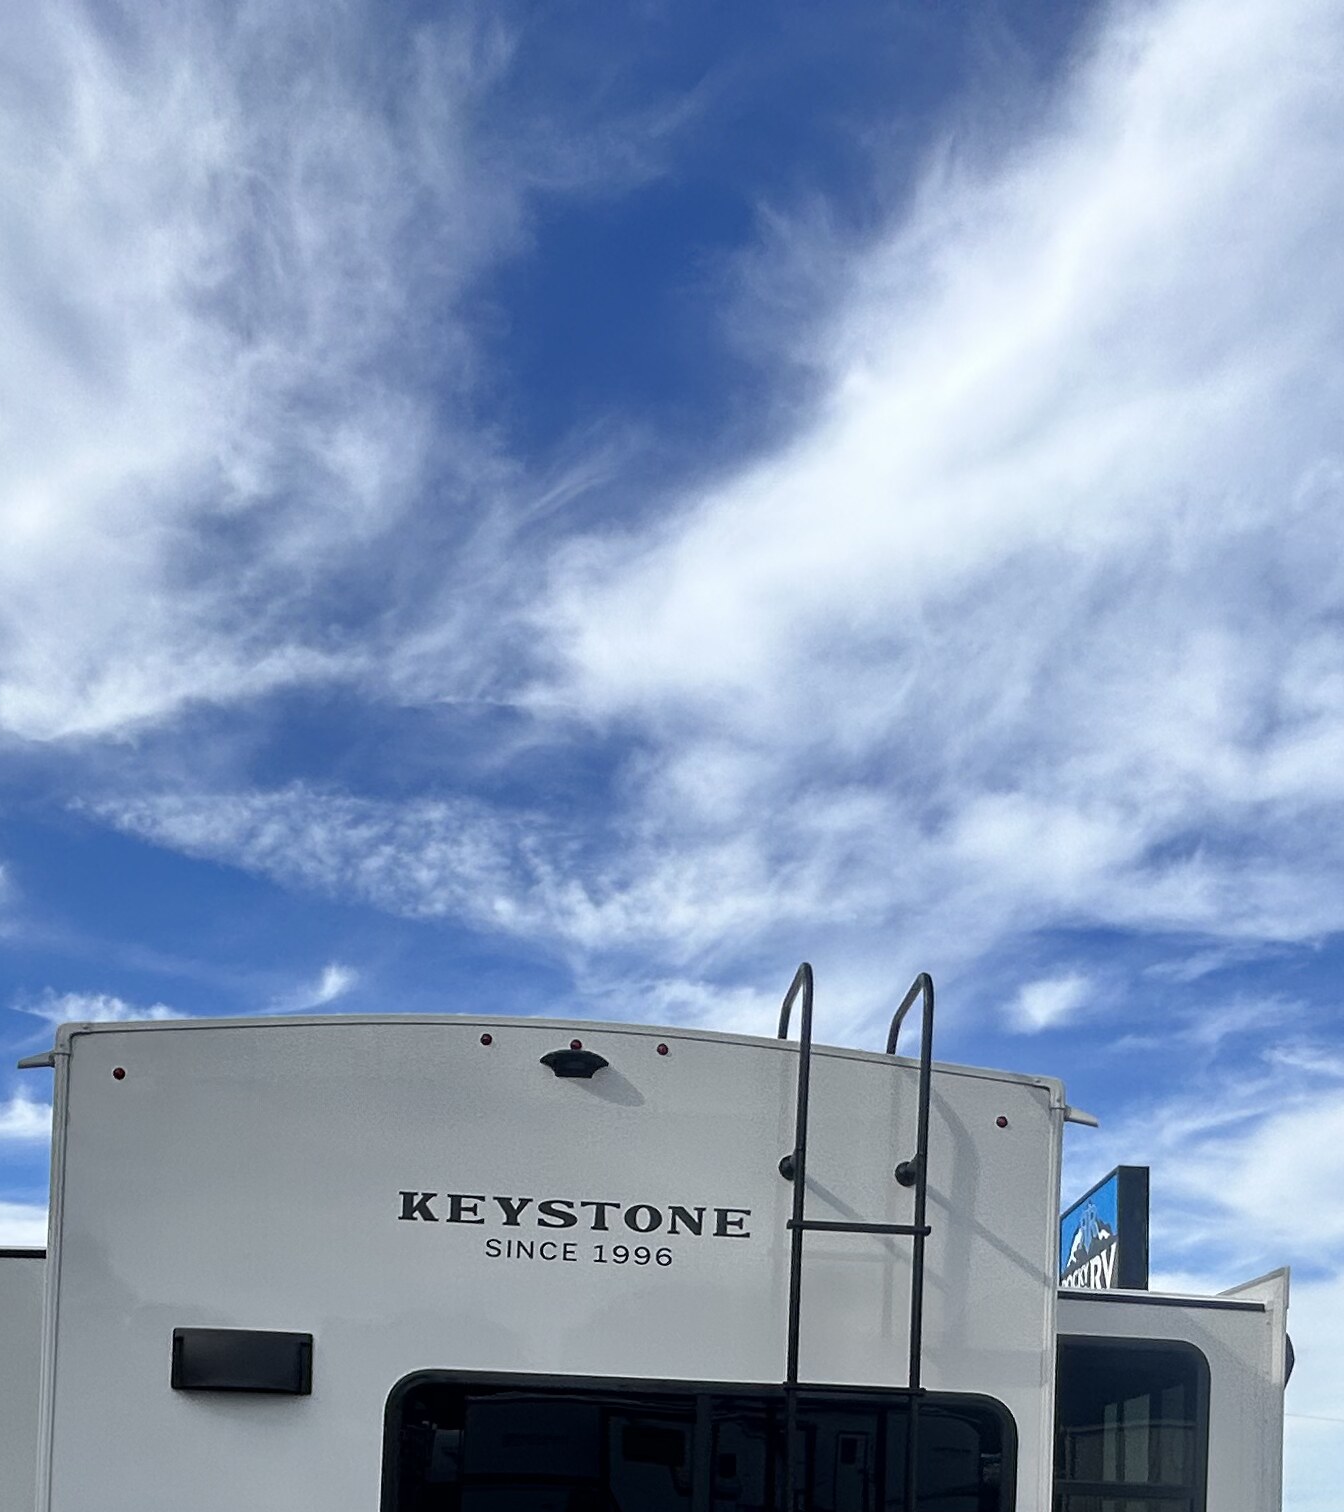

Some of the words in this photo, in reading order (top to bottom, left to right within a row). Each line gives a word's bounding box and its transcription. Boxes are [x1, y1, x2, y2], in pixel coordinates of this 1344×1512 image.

[398, 1190, 752, 1239] KEYSTONE
[485, 1238, 578, 1262] SINCE
[593, 1244, 673, 1267] 1996
[1089, 1241, 1117, 1289] RV
